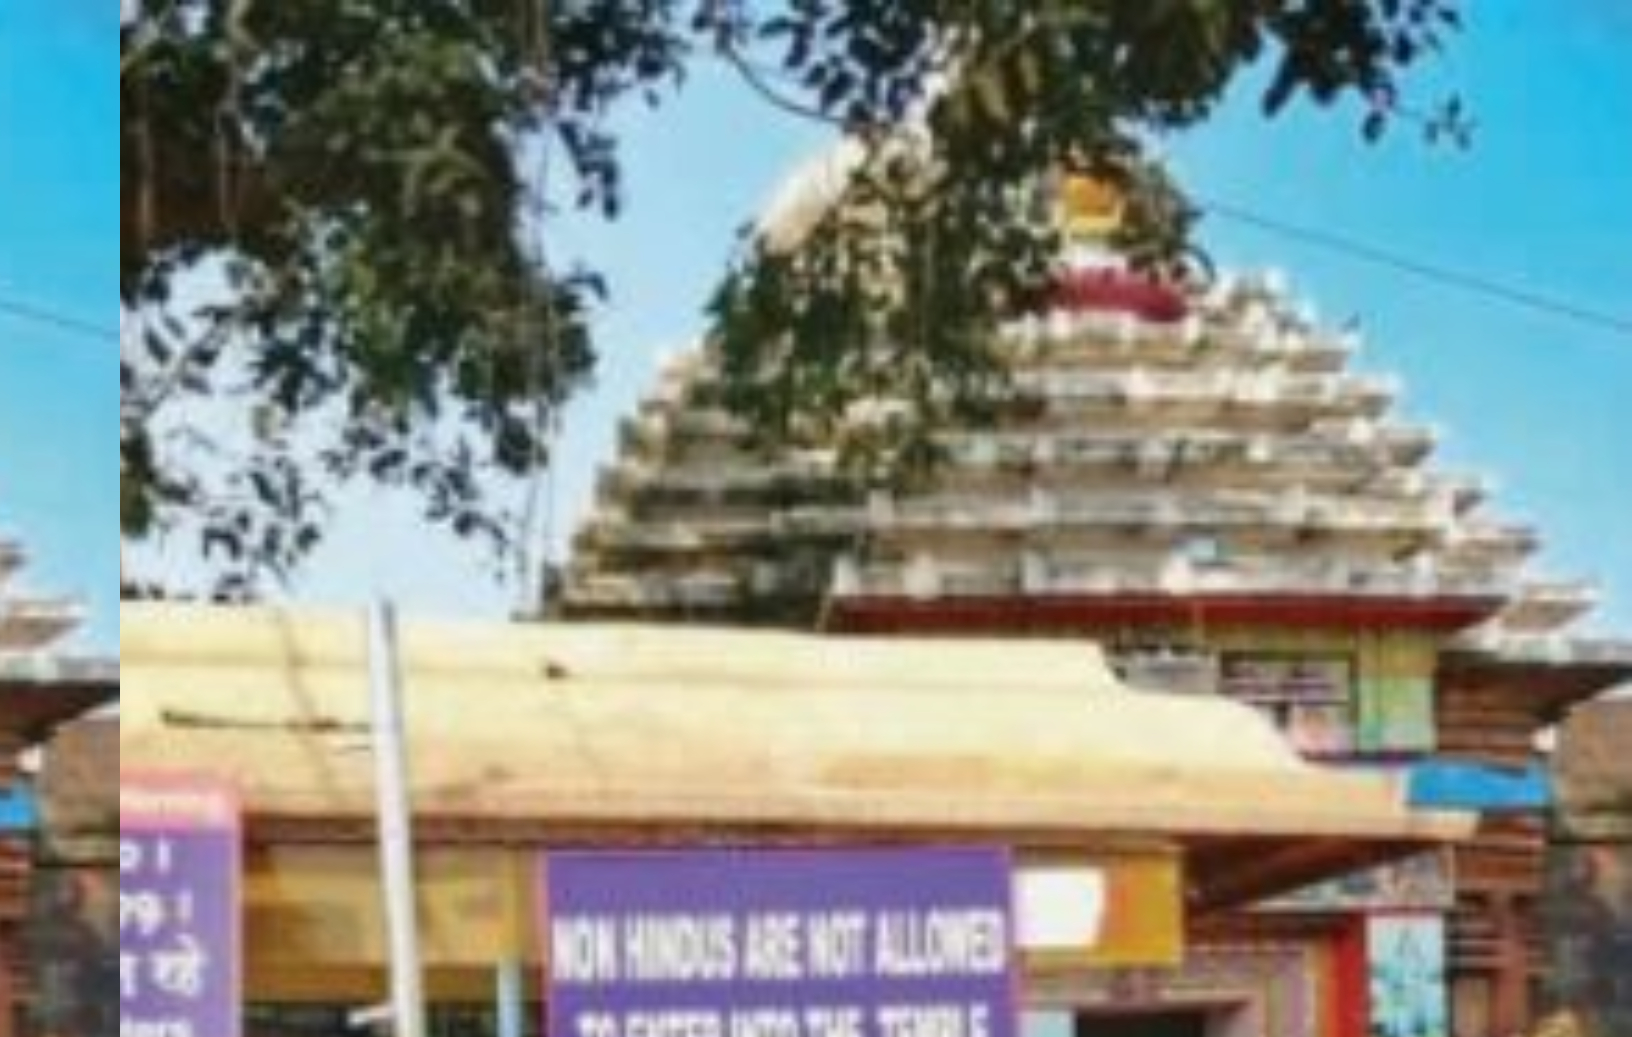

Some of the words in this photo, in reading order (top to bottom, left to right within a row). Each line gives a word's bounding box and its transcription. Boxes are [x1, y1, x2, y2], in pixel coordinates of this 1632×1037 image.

[551, 915, 618, 981] NON
[625, 913, 737, 981] HINDUS
[745, 912, 803, 980] ARE
[808, 910, 867, 978] NOT
[875, 907, 1006, 976] ALLOWED
